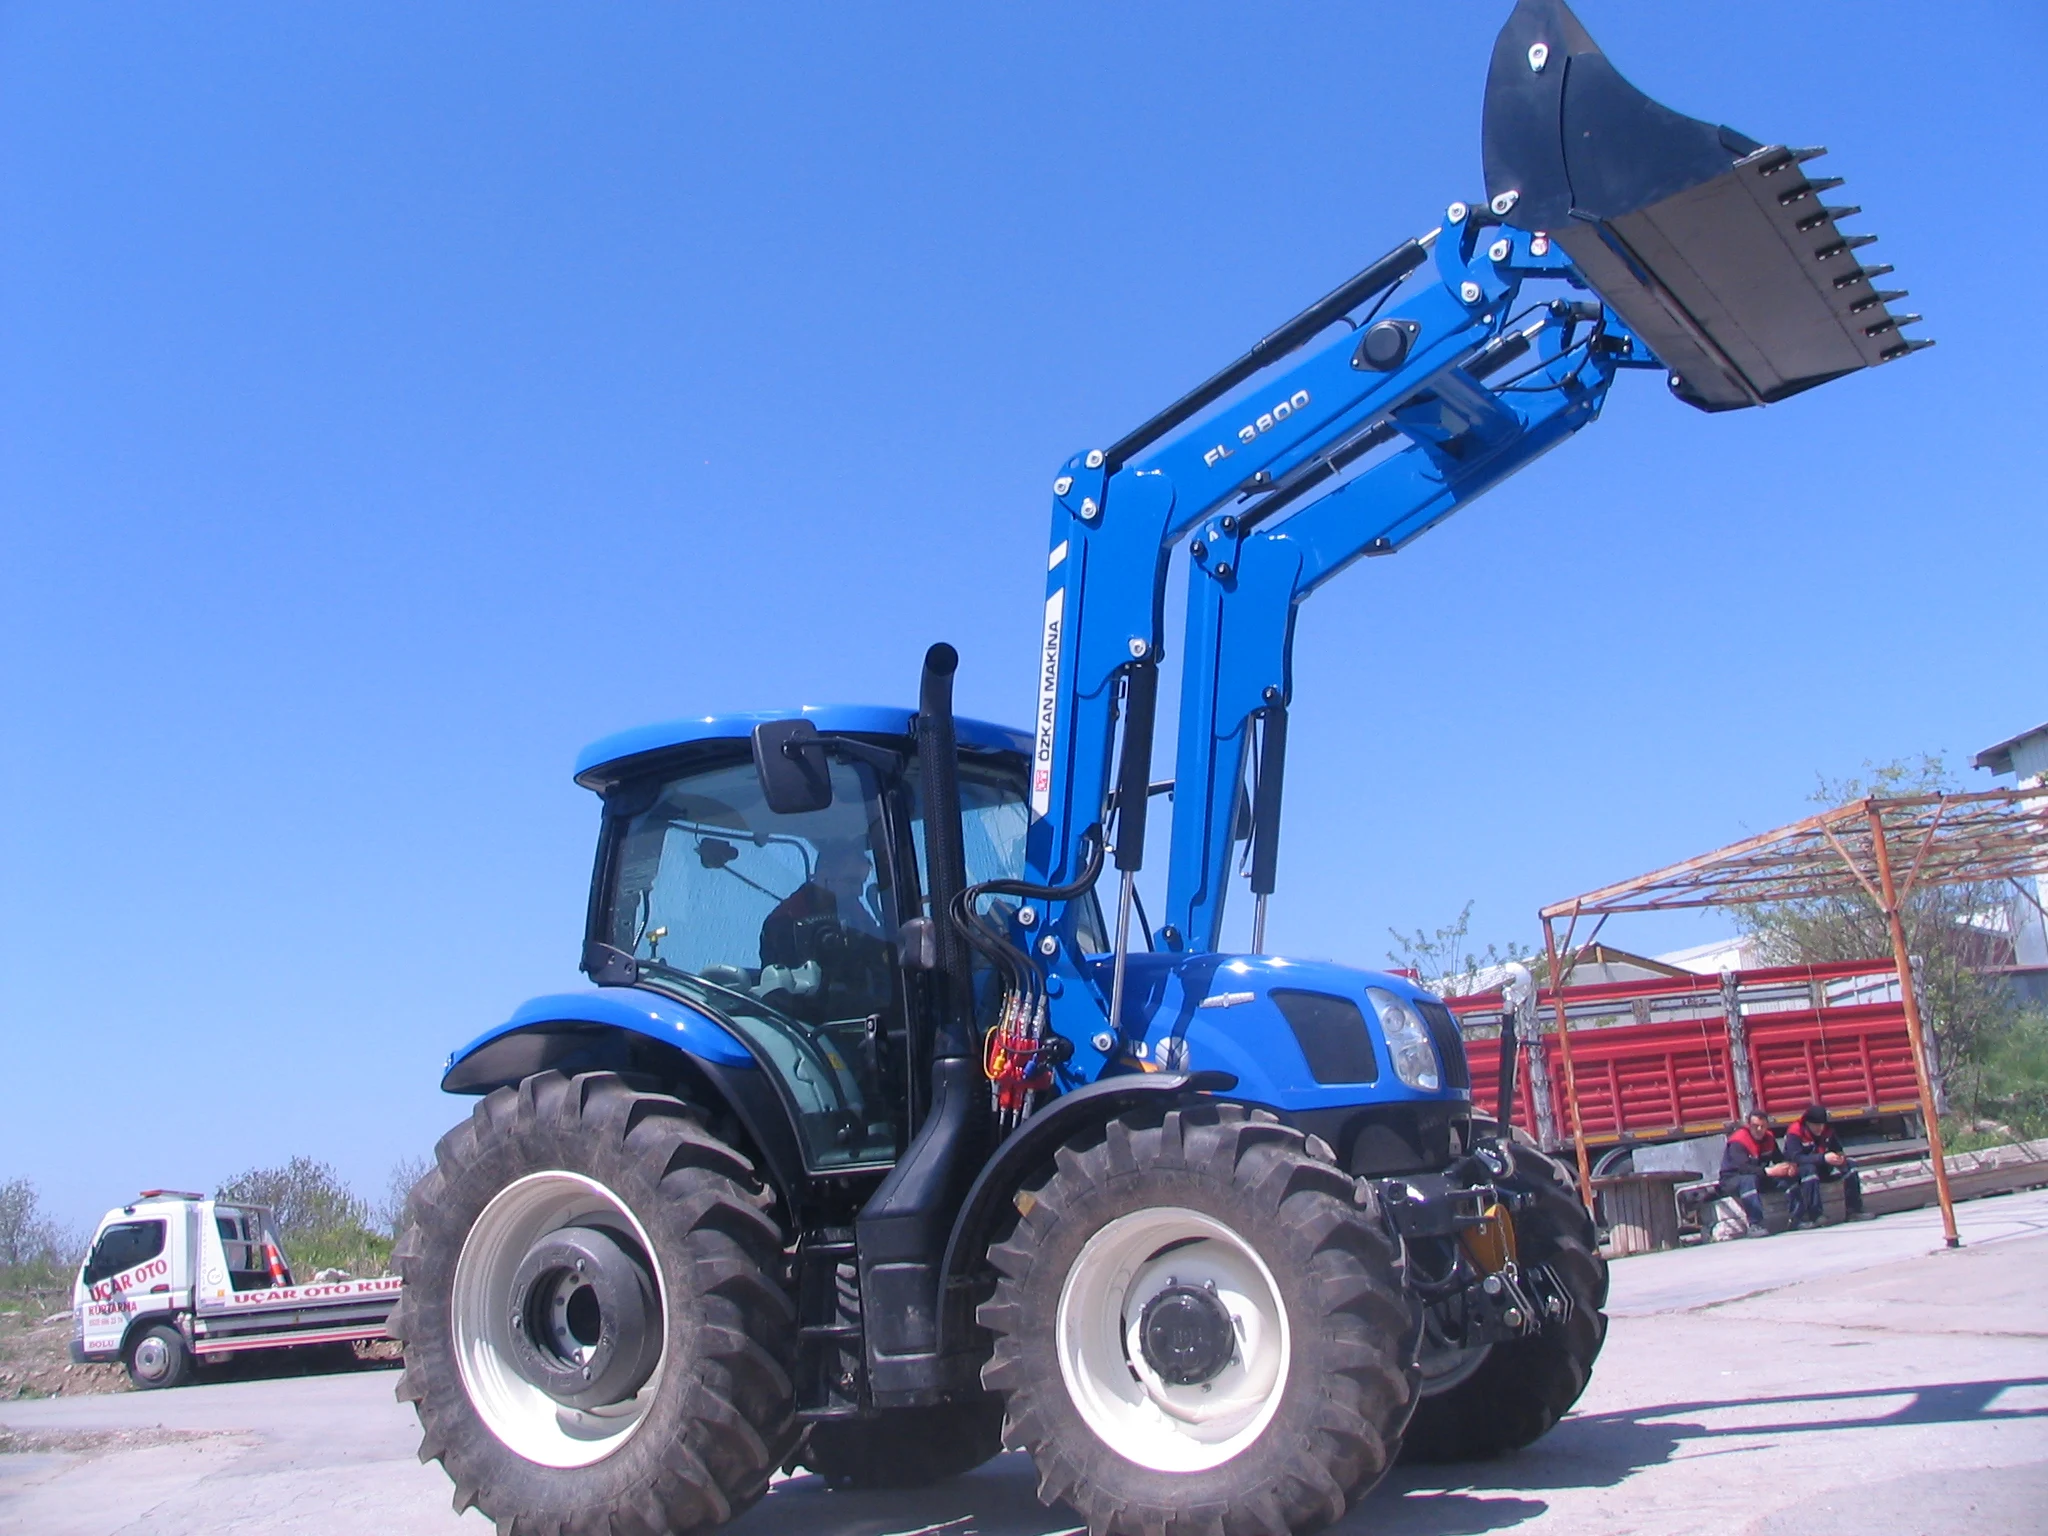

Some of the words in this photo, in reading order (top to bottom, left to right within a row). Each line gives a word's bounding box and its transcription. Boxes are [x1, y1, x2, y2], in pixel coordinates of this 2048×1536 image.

[1203, 444, 1235, 468] FL
[1238, 390, 1310, 444] 3800
[1043, 620, 1060, 692] MAKİNA
[1038, 697, 1054, 761] ÖZKAN
[89, 1273, 133, 1303] UÇAR
[135, 1259, 168, 1284] OTO
[233, 1289, 298, 1304] UÇAR
[304, 1285, 350, 1297] OTO
